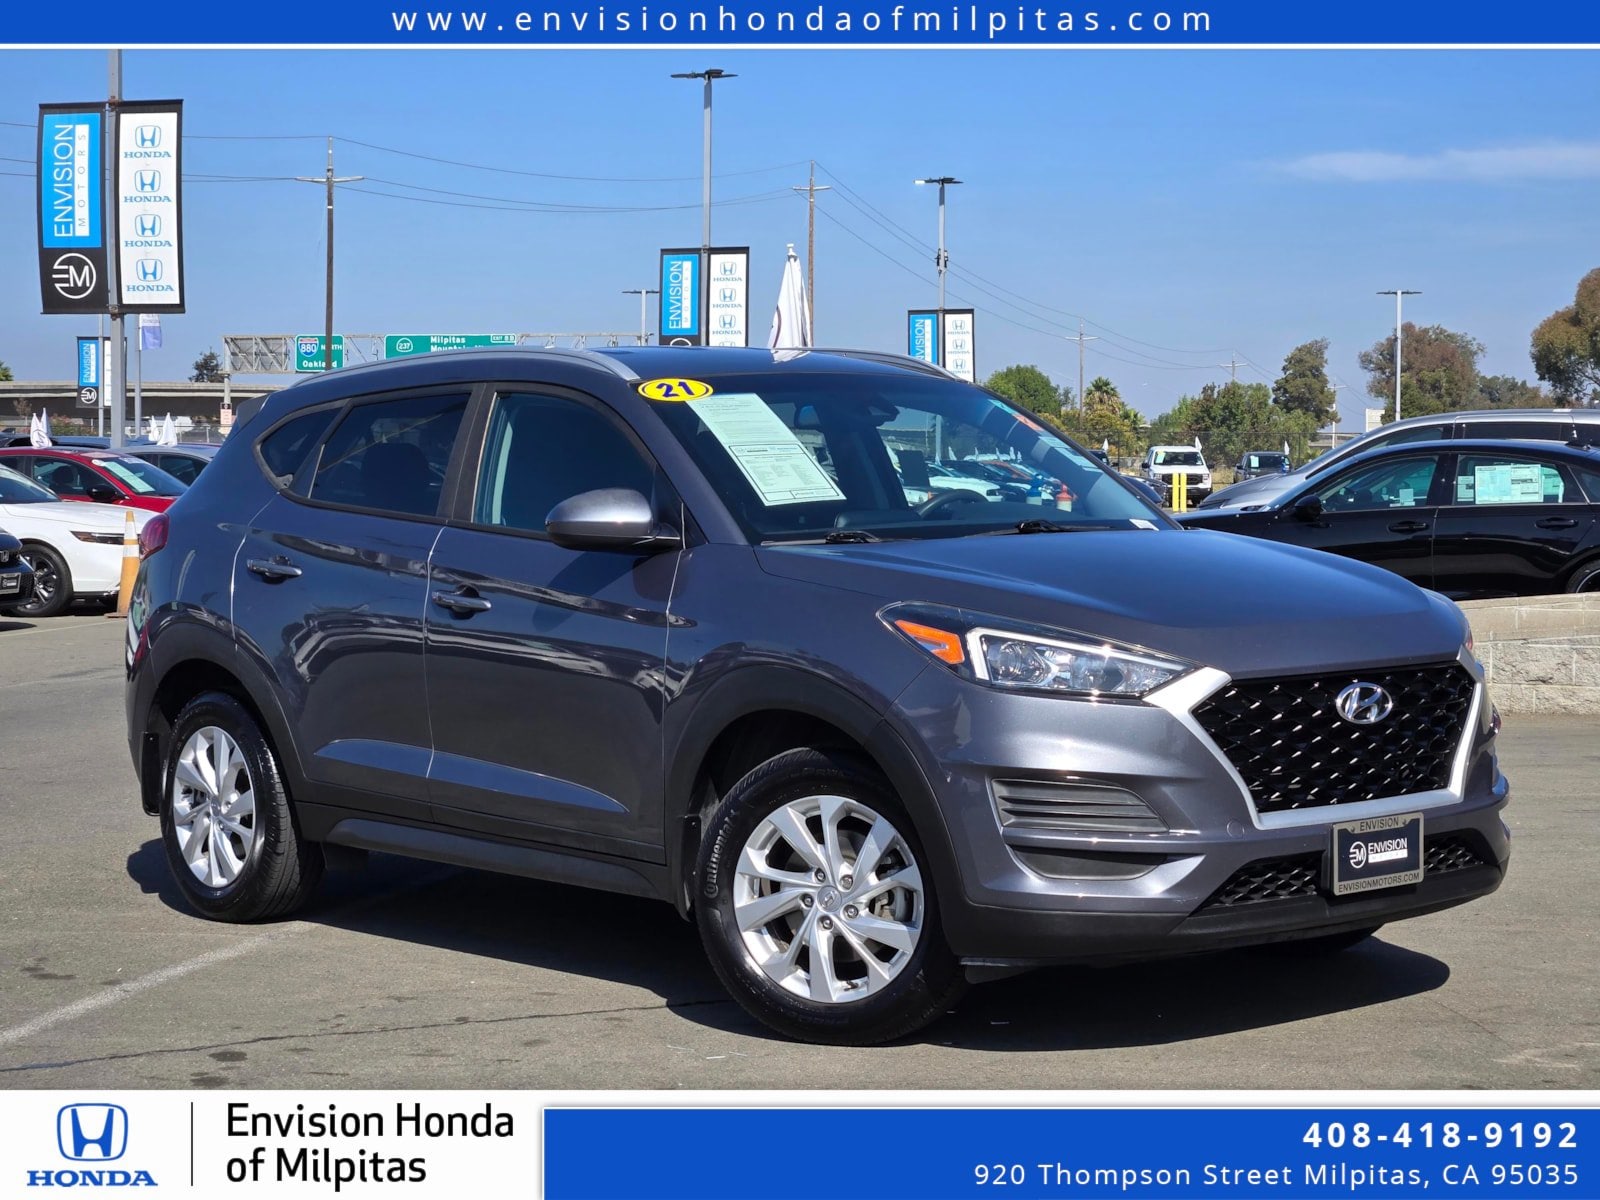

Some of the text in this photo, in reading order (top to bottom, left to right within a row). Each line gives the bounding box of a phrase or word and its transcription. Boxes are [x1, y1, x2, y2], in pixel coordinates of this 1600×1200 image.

[54, 124, 73, 236] ENVISION
[78, 134, 86, 227] MOTORS
[126, 284, 175, 292] HONDA
[669, 261, 682, 329] ENVISION
[301, 343, 343, 353] 880 NRTH
[398, 342, 411, 350] 237
[430, 335, 466, 345] Milpitas
[915, 319, 925, 360] VISION
[302, 360, 337, 368] Oaklad
[656, 381, 695, 398] 21
[1360, 816, 1399, 832] ENVISION
[1368, 837, 1407, 855] ENVISION
[1338, 871, 1420, 893] ENVISIONMOTORS.COM
